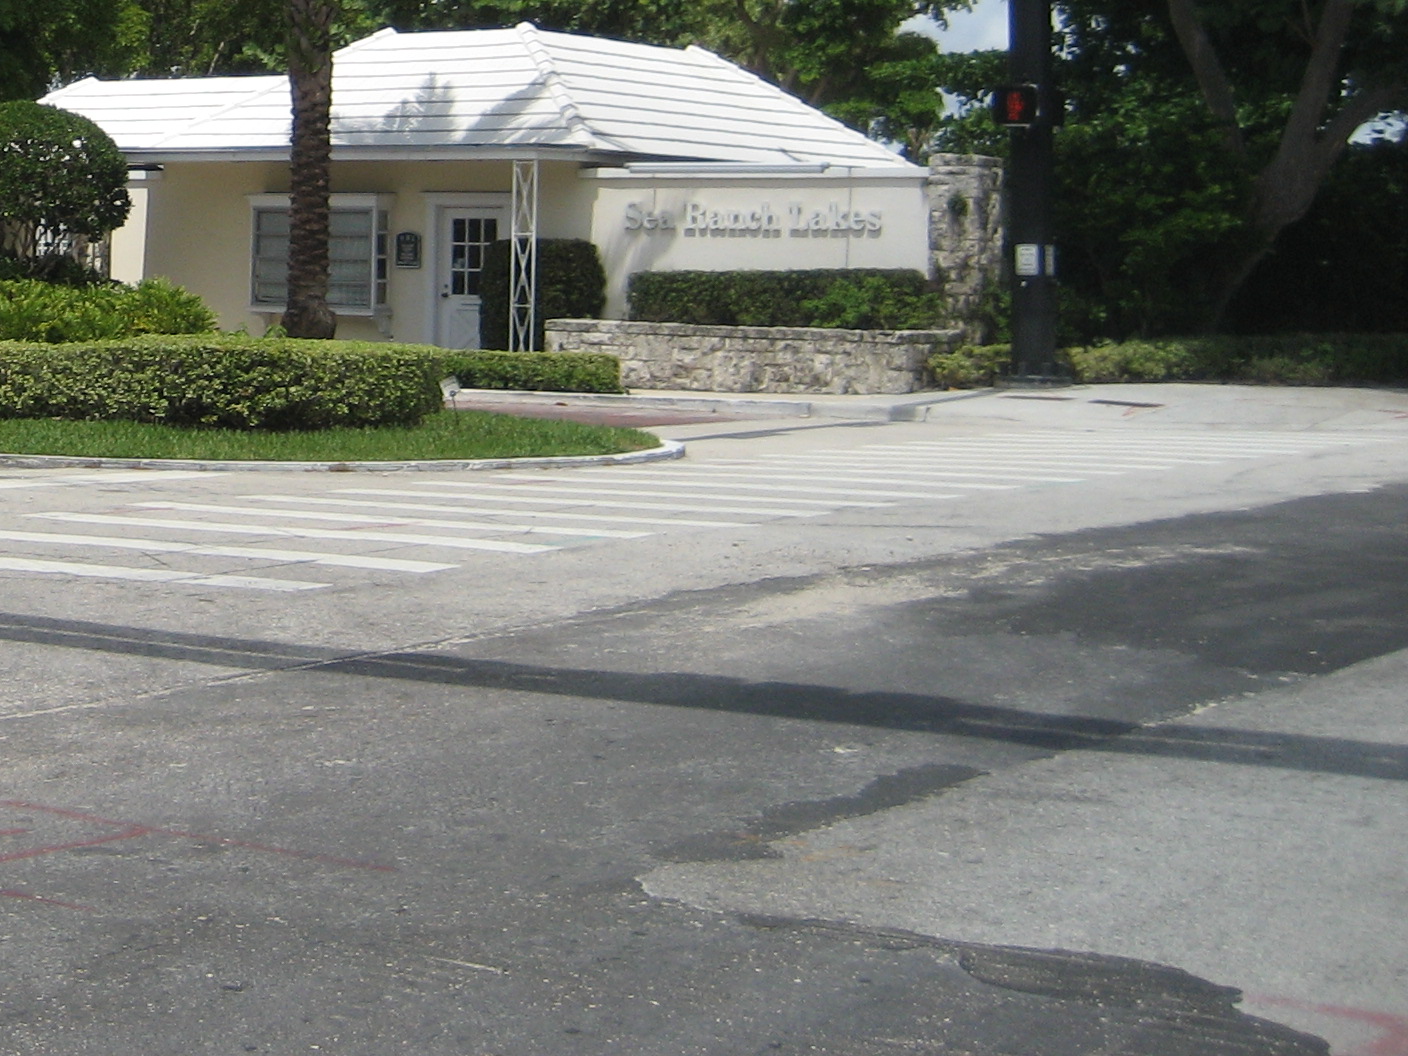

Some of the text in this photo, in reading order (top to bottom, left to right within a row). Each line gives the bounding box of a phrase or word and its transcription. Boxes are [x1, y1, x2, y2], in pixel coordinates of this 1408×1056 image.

[624, 201, 882, 233] Sea Ranch Lakes
